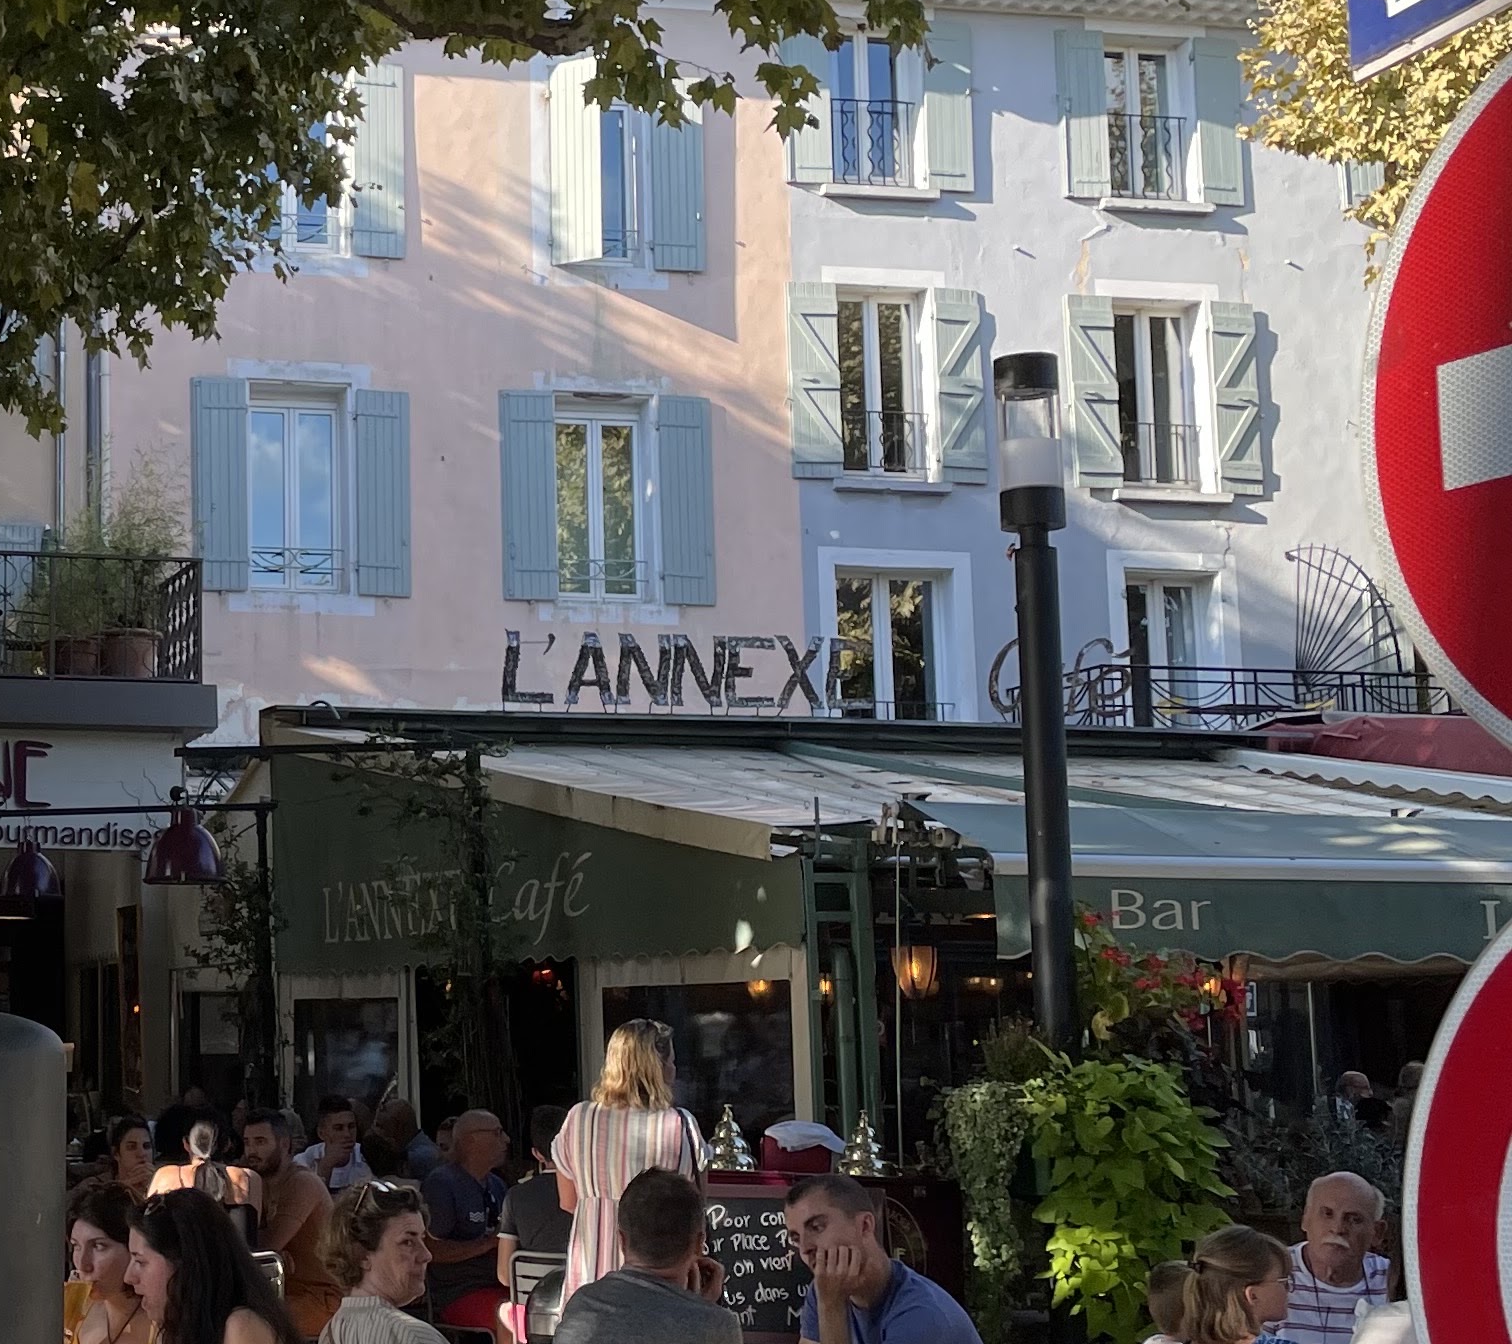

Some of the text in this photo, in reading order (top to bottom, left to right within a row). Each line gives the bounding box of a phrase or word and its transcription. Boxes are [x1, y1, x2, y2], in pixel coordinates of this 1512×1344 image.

[501, 629, 875, 708] L'ANNEXE
[487, 852, 592, 946] Café
[1110, 889, 1212, 931] Bar
[733, 1258, 754, 1276] on
[754, 1281, 789, 1302] dans
